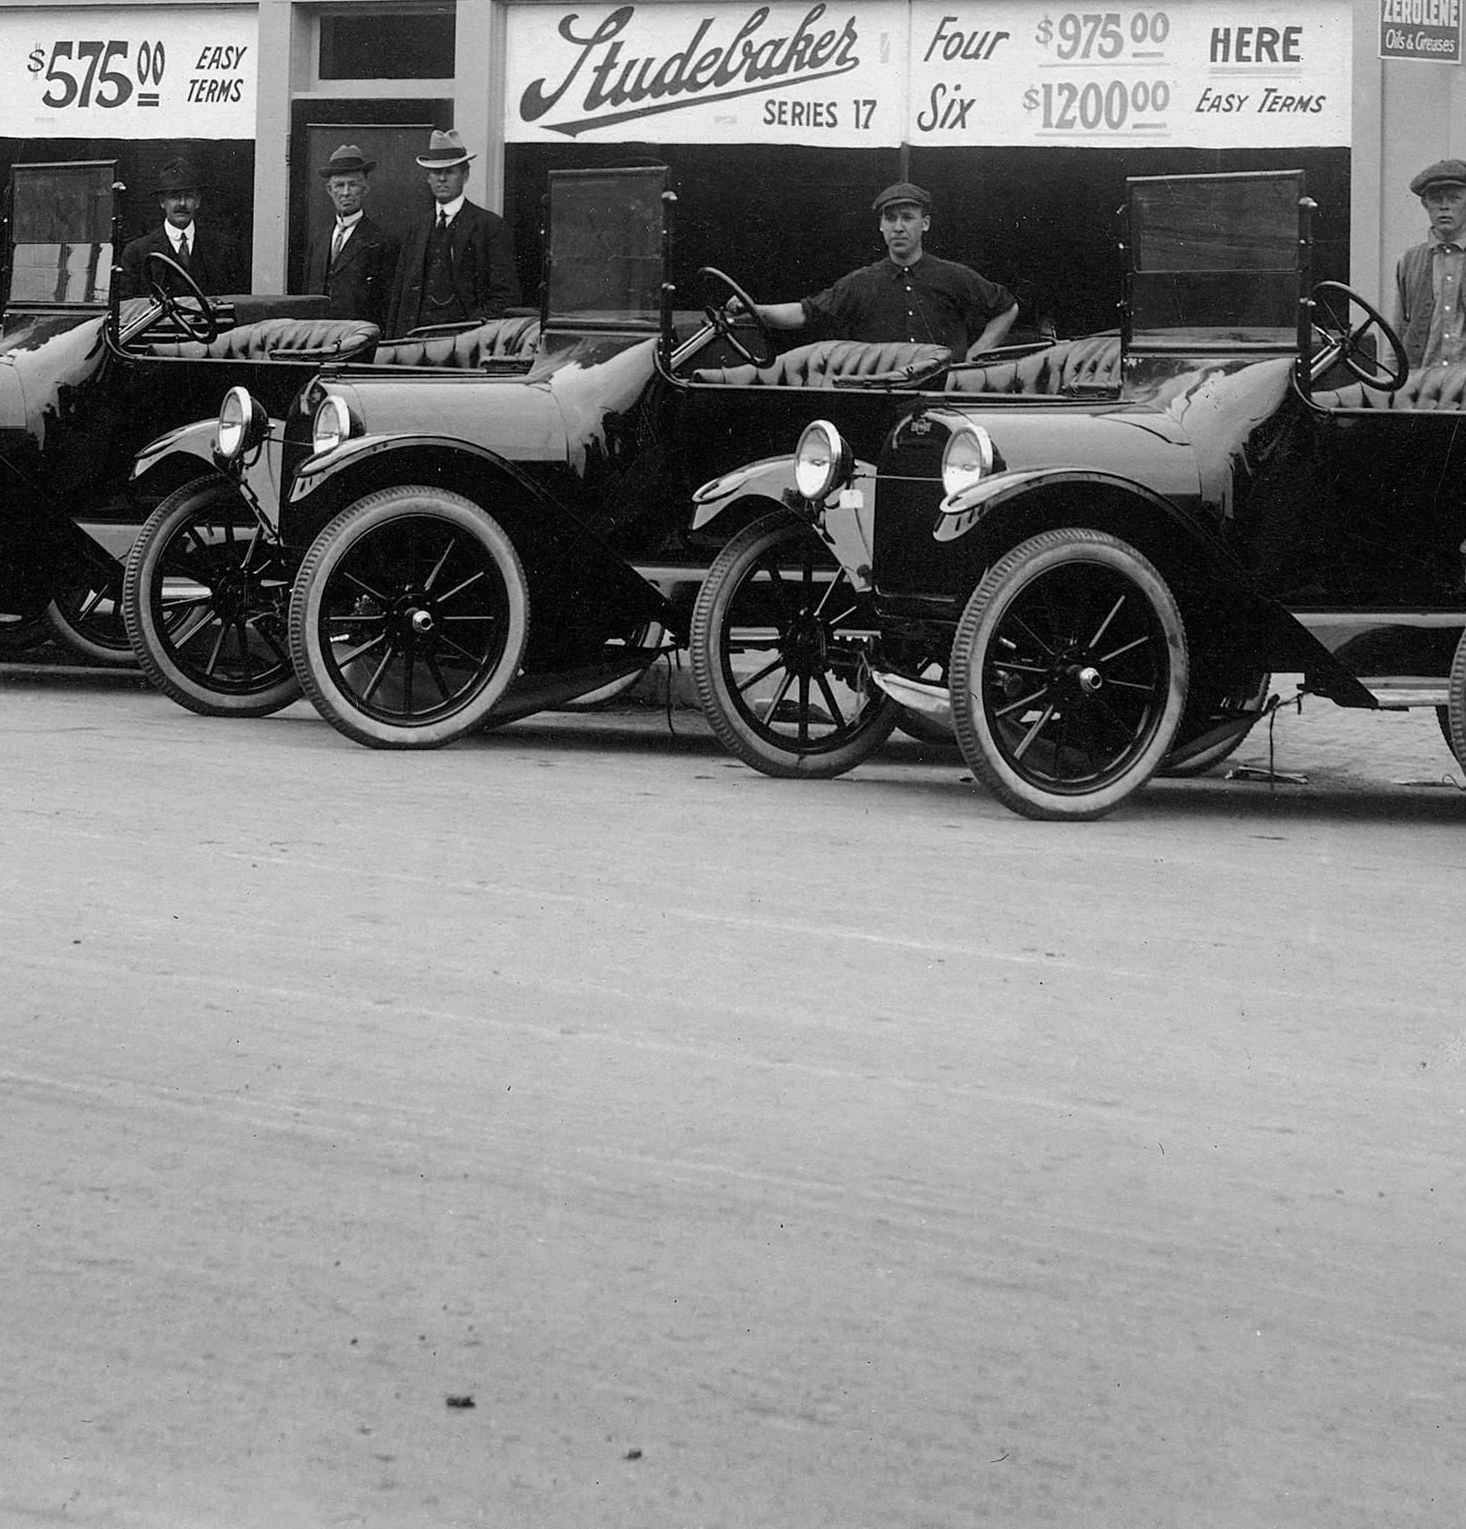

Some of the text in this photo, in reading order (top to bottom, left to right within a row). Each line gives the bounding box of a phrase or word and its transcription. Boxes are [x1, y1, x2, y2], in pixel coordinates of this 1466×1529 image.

[923, 15, 1011, 62] Four
[1208, 25, 1304, 64] HERE
[1385, 28, 1455, 53] Oils & Greases
[194, 45, 248, 71] EASY
[519, 2, 860, 137] Studebaker
[186, 78, 245, 104] TERMS
[916, 82, 977, 132] Six
[1194, 86, 1327, 116] EASY TERMS
[762, 98, 878, 131] SERIES 17
